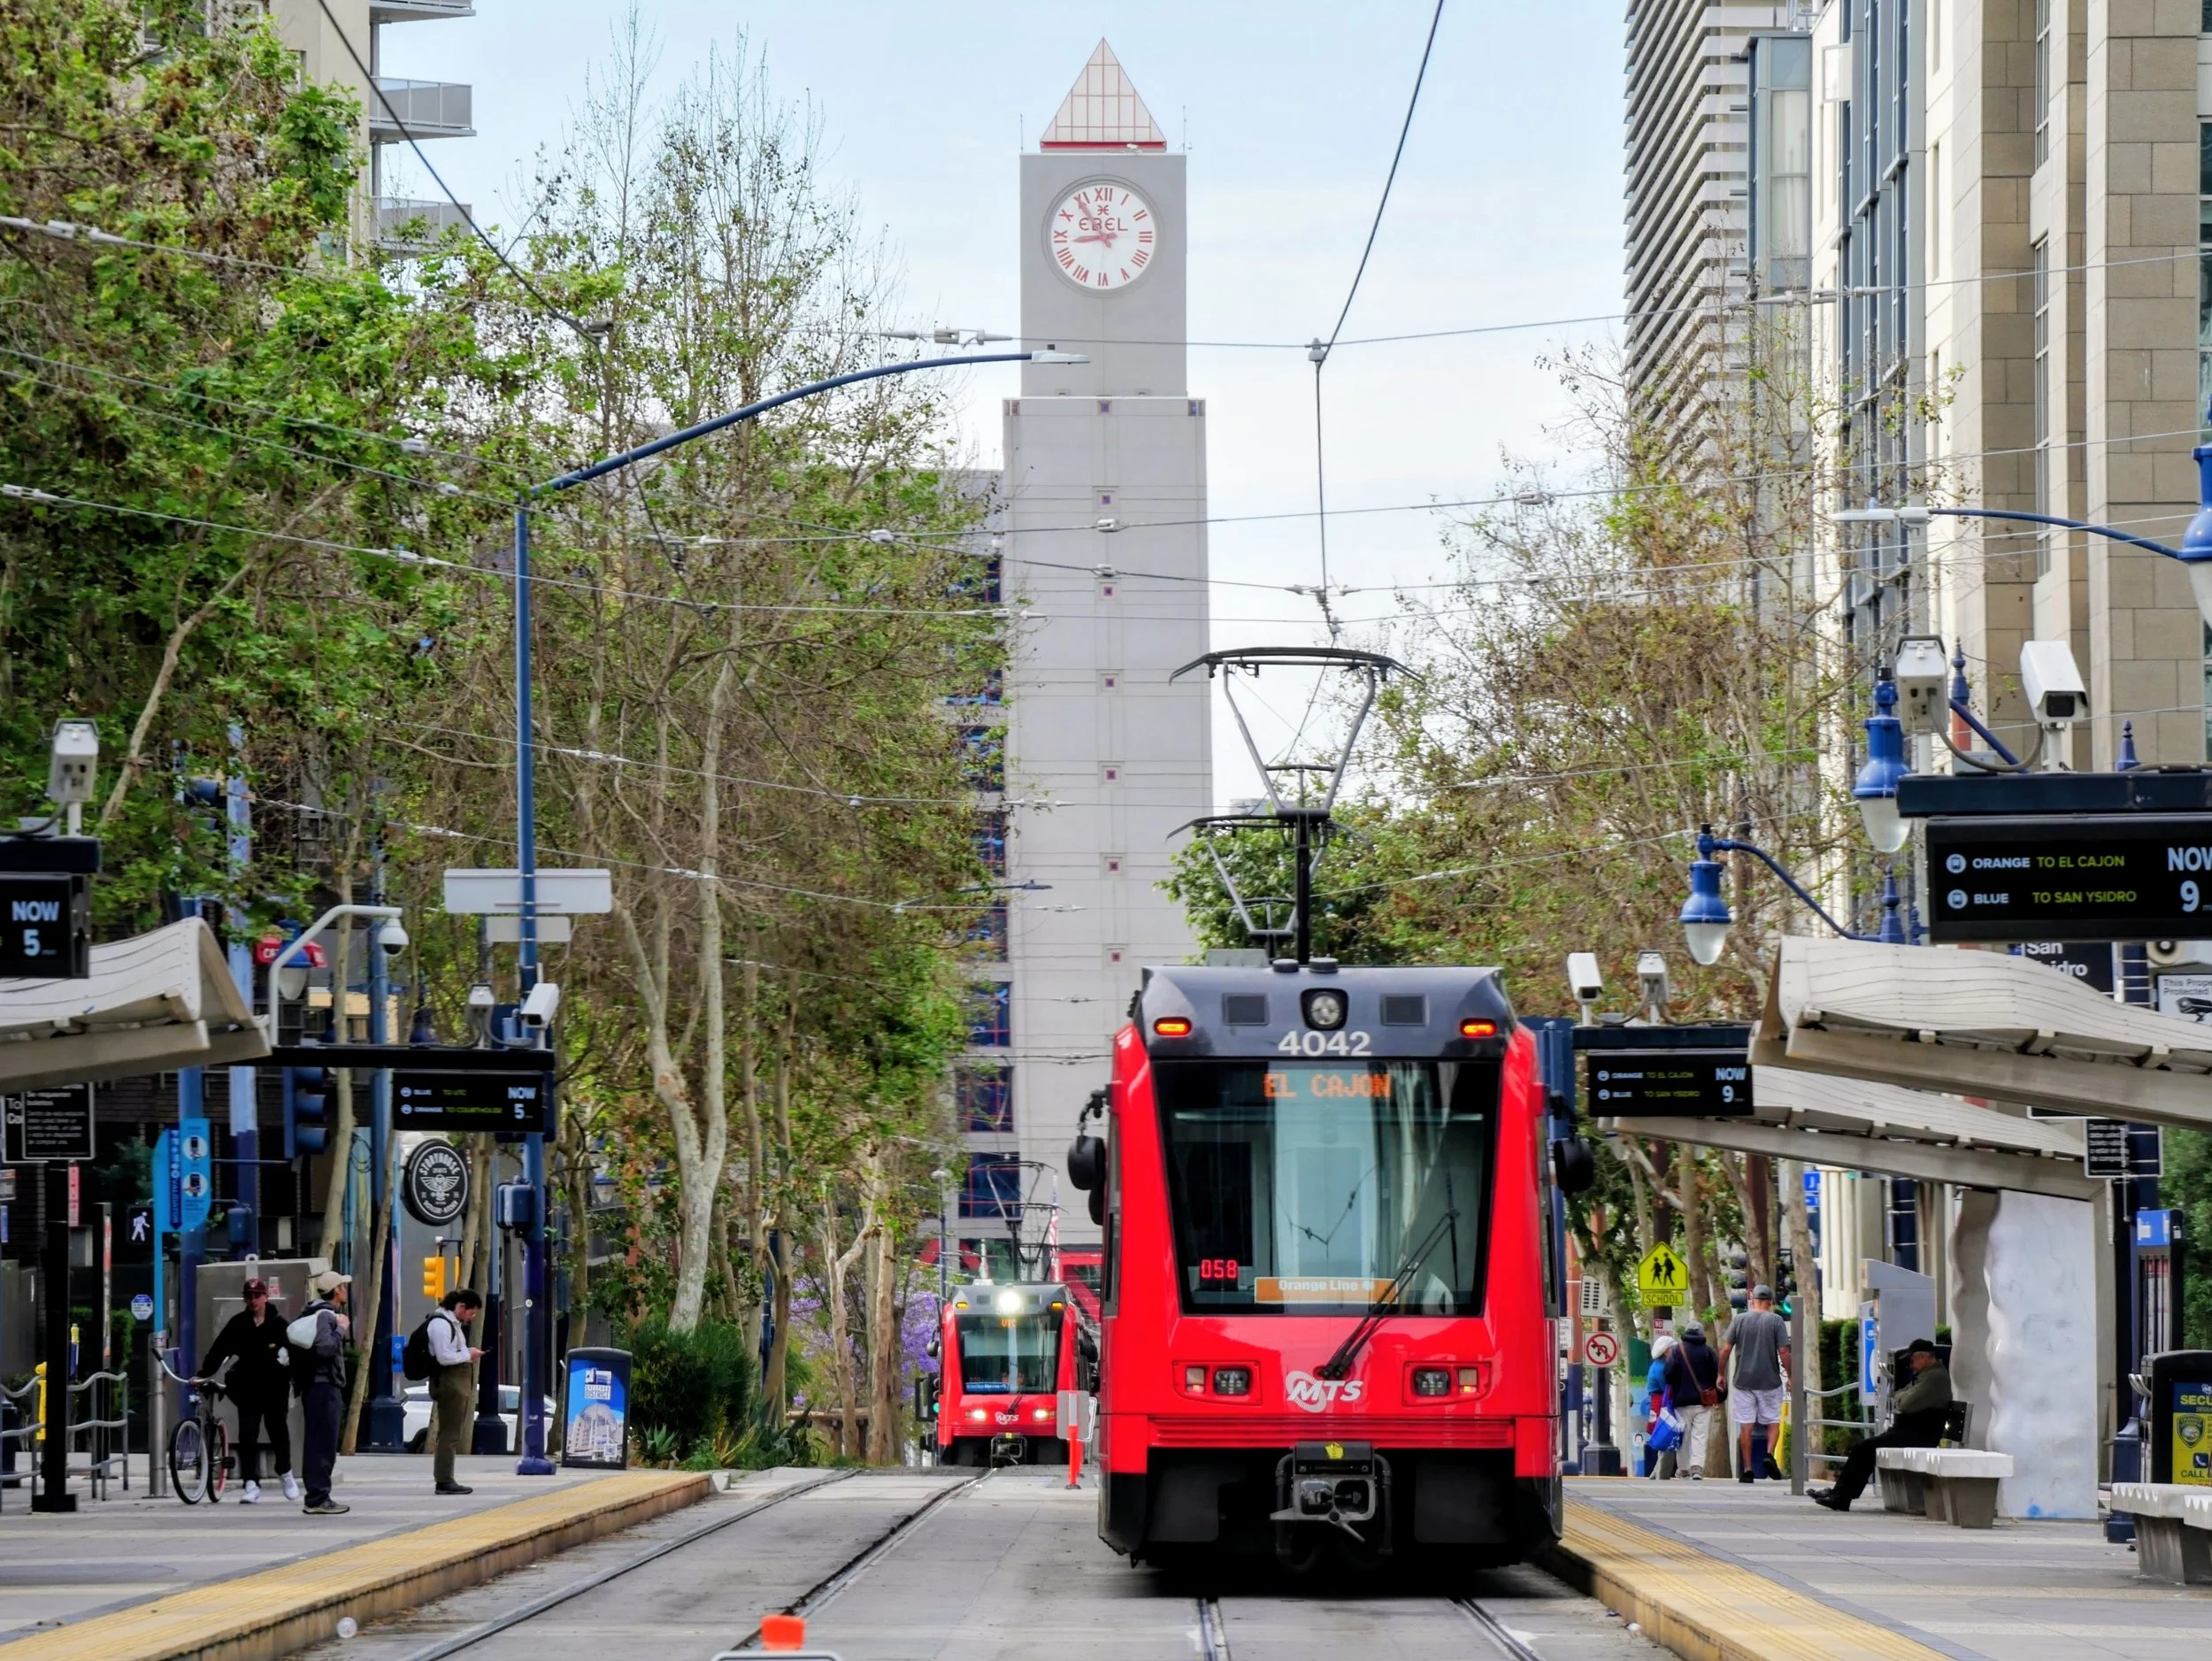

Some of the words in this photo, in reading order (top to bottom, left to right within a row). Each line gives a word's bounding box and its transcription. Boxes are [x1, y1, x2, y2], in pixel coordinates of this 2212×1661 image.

[1094, 188, 1113, 202] XII
[1058, 209, 1074, 221] X
[1133, 209, 1148, 221] II
[1079, 218, 1128, 232] EBEL
[1054, 230, 1067, 243] IX
[1139, 230, 1153, 243] III
[1120, 267, 1131, 281] V
[1972, 857, 2031, 869] ORANGE
[2037, 857, 2055, 868] TO
[2059, 857, 2074, 868] EL
[2078, 856, 2125, 868] CAJON
[1973, 893, 2009, 904] BLUE
[2032, 892, 2052, 904] TO
[2055, 892, 2083, 904] SAN
[2086, 890, 2137, 903] YSIDRO
[2180, 880, 2200, 912] 9
[12, 900, 60, 922] NOW
[23, 929, 41, 957] 5
[2026, 942, 2063, 955] San
[1278, 1030, 1372, 1057] 4042
[1715, 1067, 1747, 1081] NOW
[1263, 1073, 1297, 1097] EL
[1310, 1073, 1393, 1097] CAJON
[508, 1087, 536, 1099] NOW
[1722, 1085, 1734, 1103] 9
[514, 1103, 526, 1119] 5
[1201, 1259, 1239, 1278] 058
[1278, 1280, 1327, 1292] Orange
[1331, 1280, 1358, 1290] Line
[1646, 1294, 1681, 1304] SCHOOL
[1286, 1380, 1364, 1402] MTS
[2180, 1469, 2205, 1478] CALL
